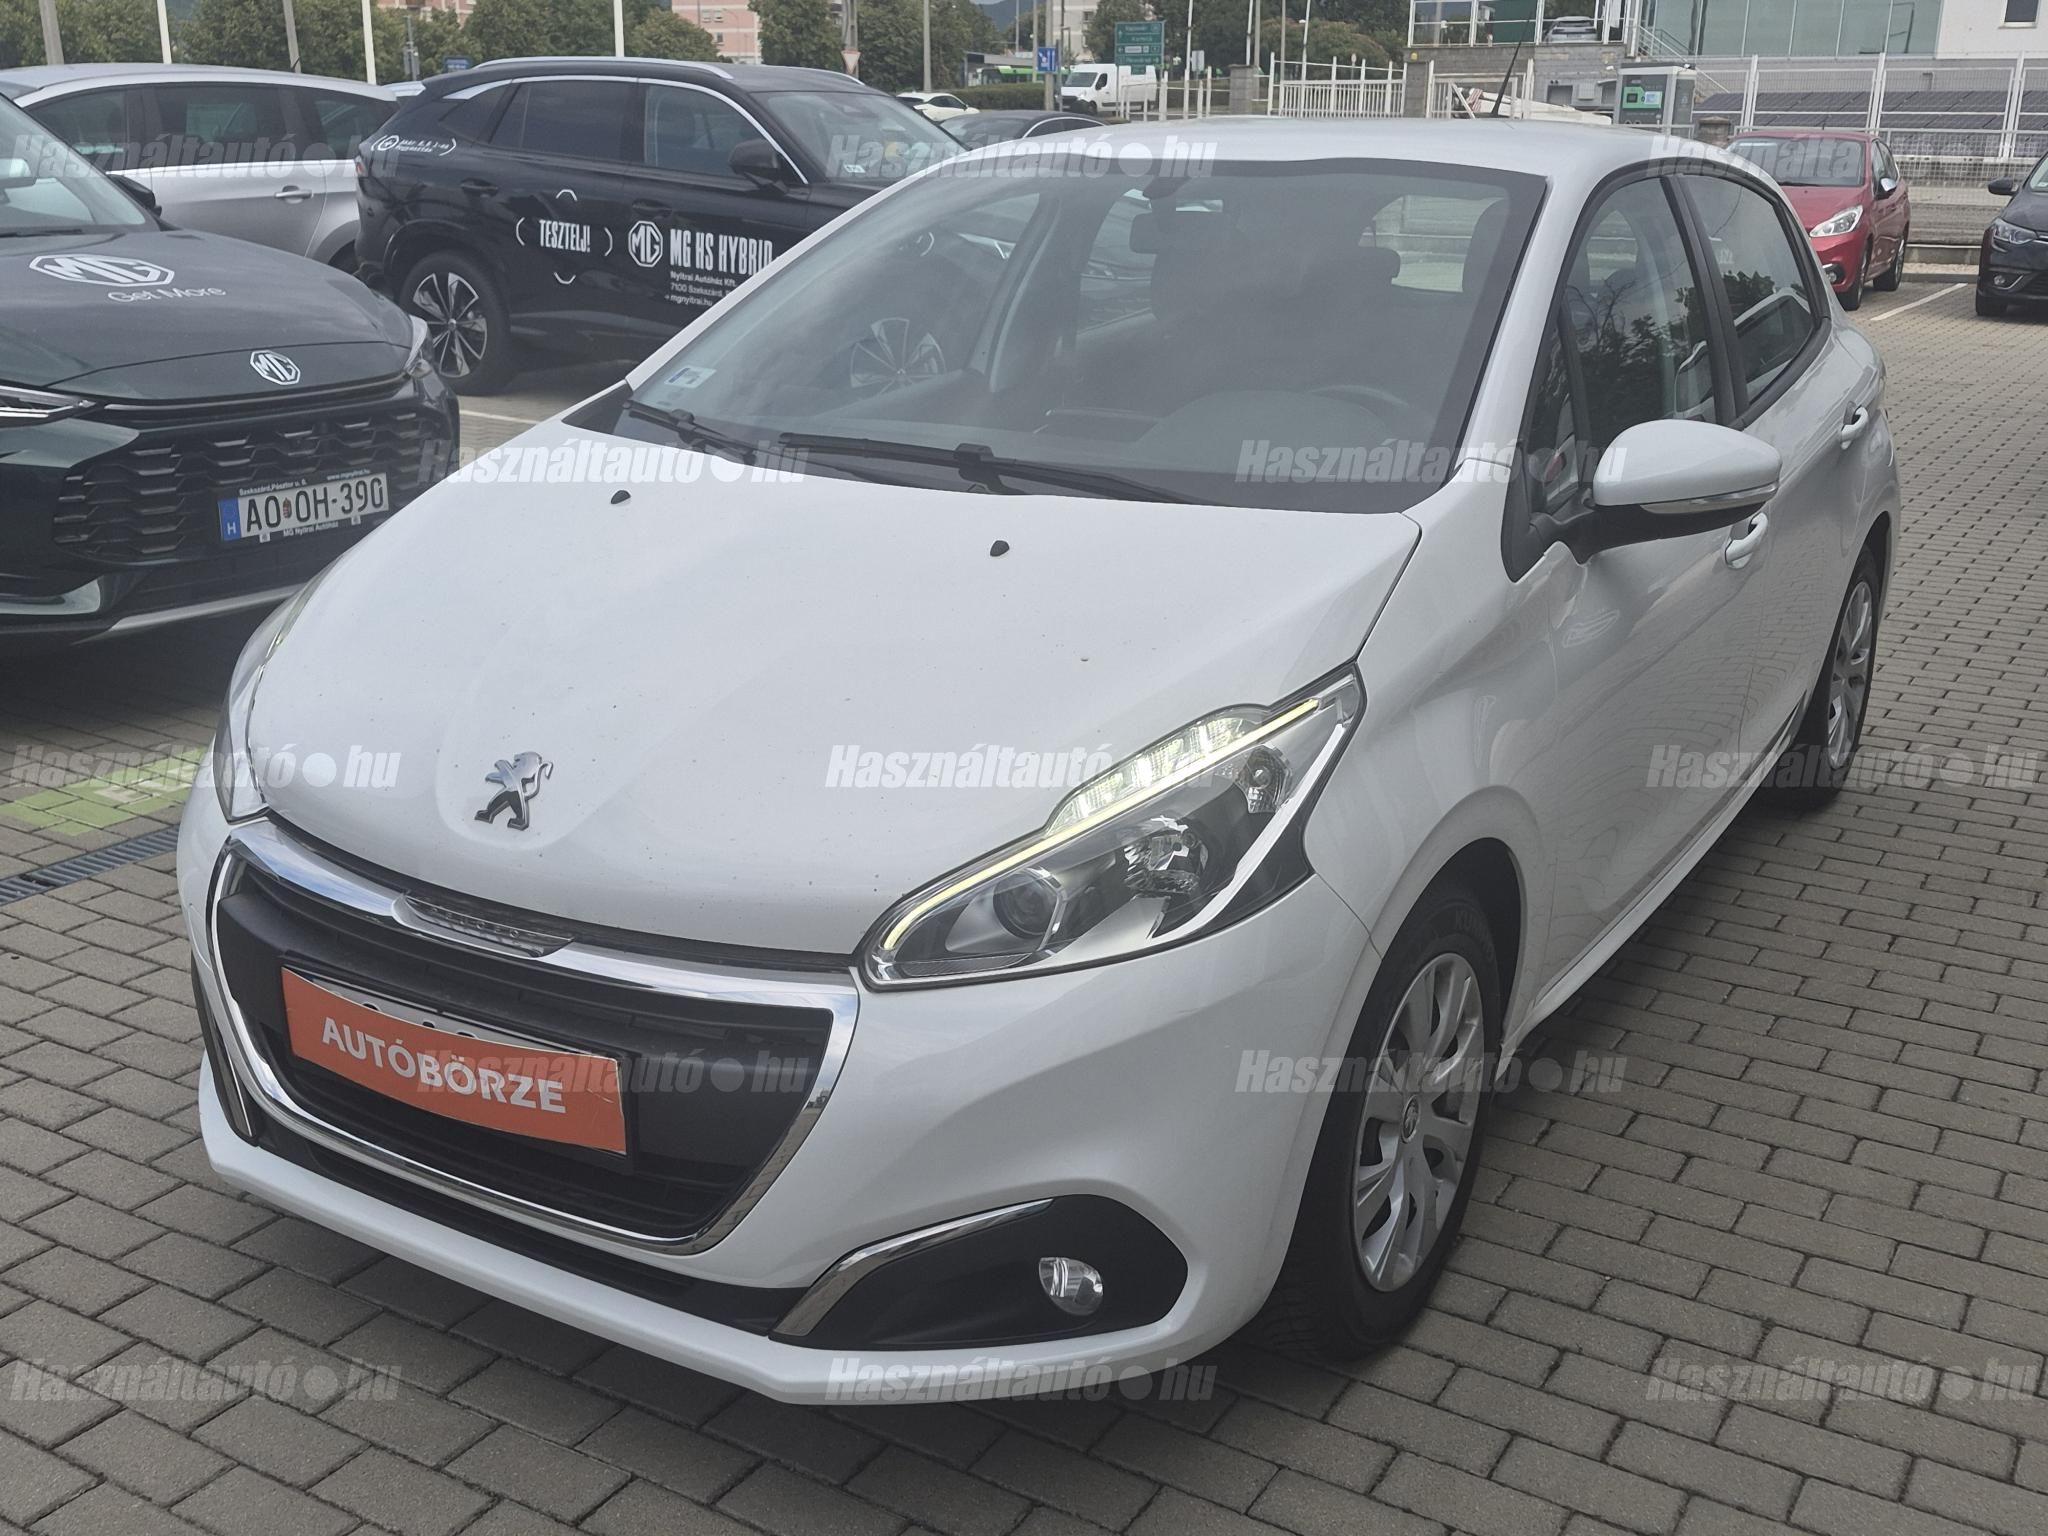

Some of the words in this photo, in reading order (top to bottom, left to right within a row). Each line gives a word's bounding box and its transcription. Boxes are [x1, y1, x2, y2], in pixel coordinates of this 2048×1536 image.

[539, 219, 591, 253] TESZTELJ!
[670, 228, 691, 267] MG
[695, 230, 714, 271] HS
[718, 235, 773, 276] HYBRID
[107, 289, 158, 302] Get
[157, 287, 226, 299] More
[246, 495, 282, 532] AO
[295, 477, 384, 523] OH-390
[226, 521, 238, 535] H
[322, 1016, 567, 1114] AUTÓBÖRZE
